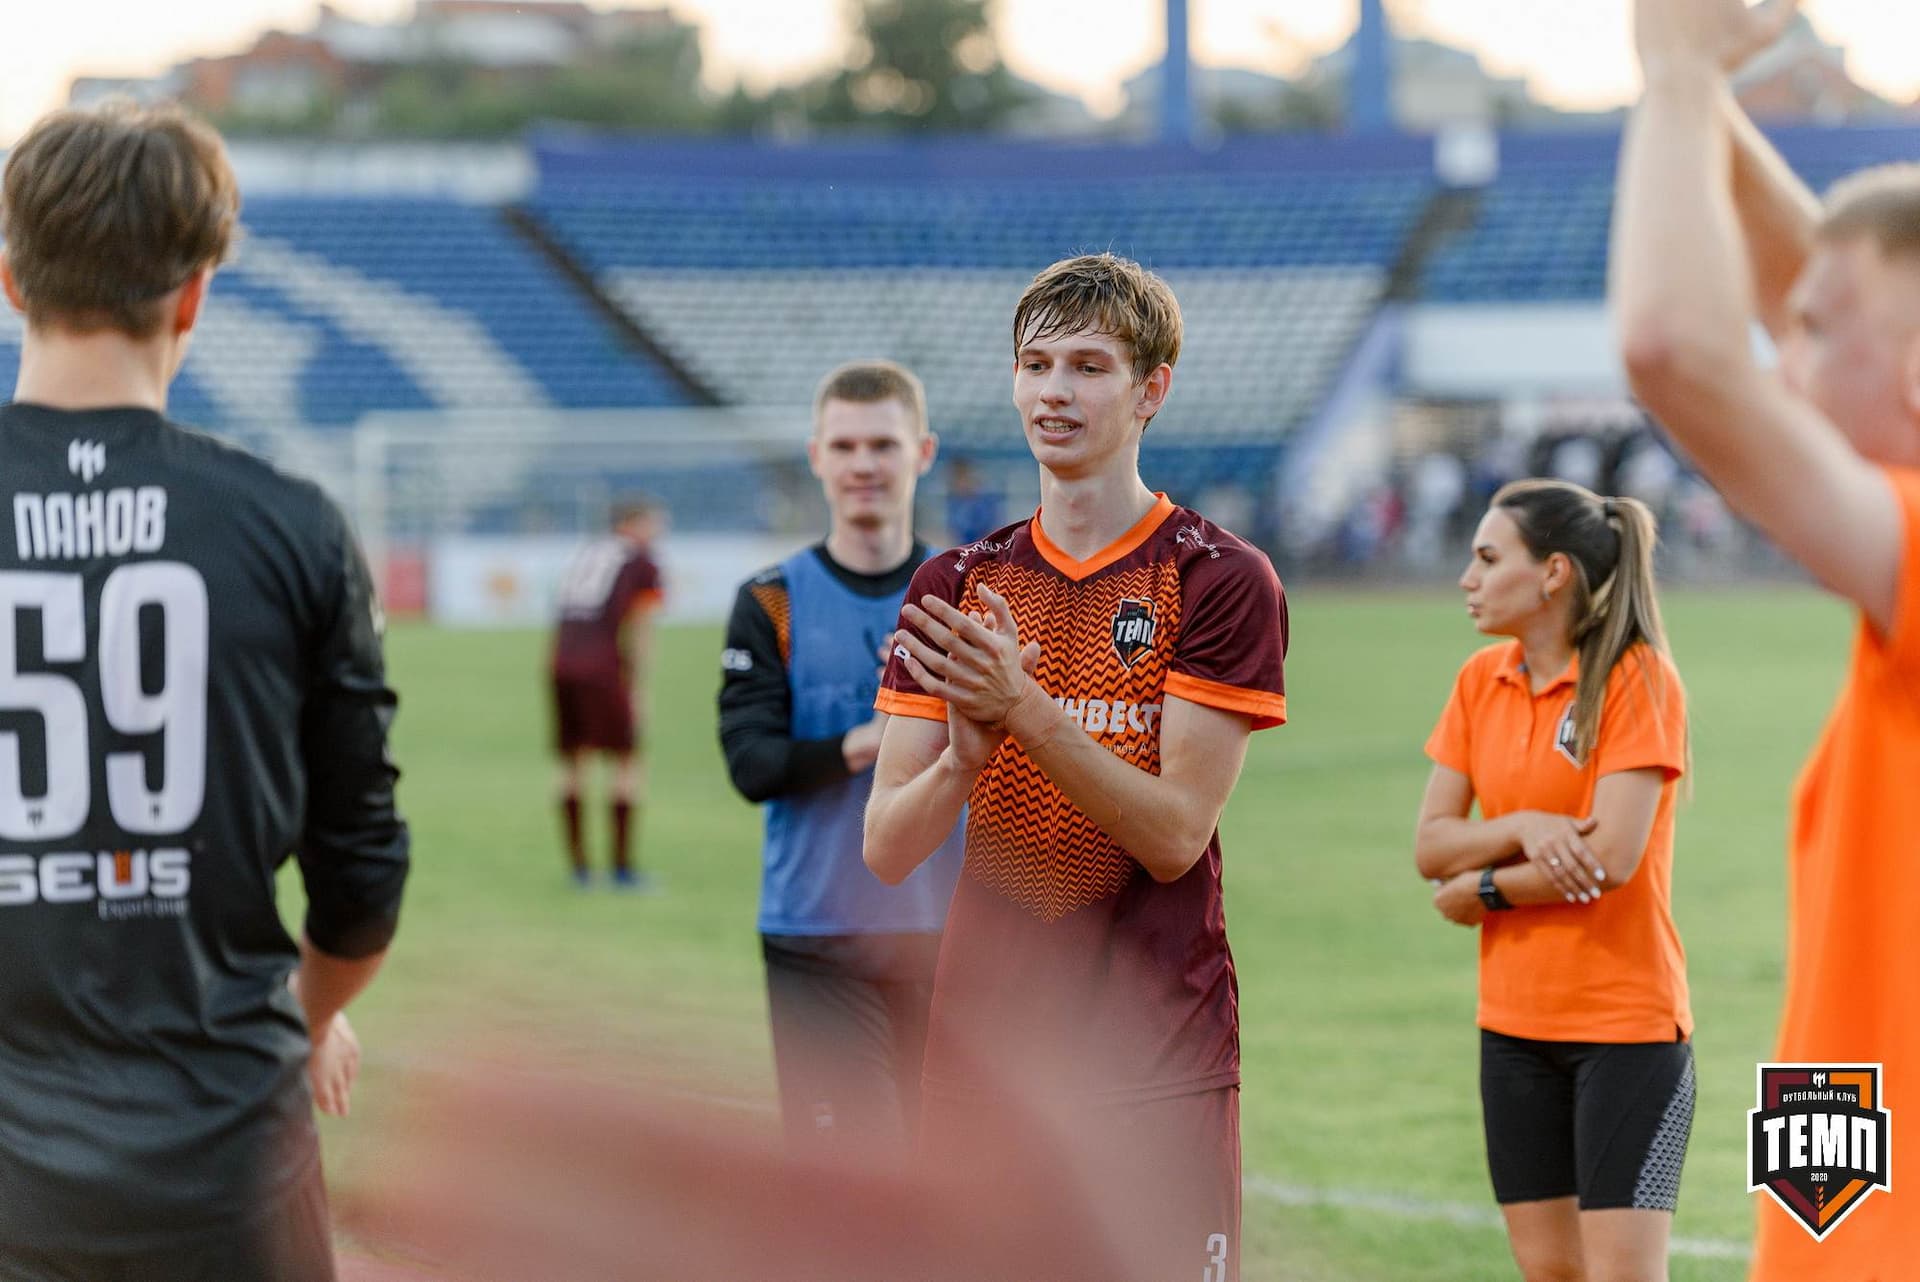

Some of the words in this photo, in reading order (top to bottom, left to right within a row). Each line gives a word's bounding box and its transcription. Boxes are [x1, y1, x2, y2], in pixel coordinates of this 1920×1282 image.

[13, 485, 168, 561] ПАНОВ
[0, 561, 209, 841] 59
[0, 848, 191, 905] SEUS
